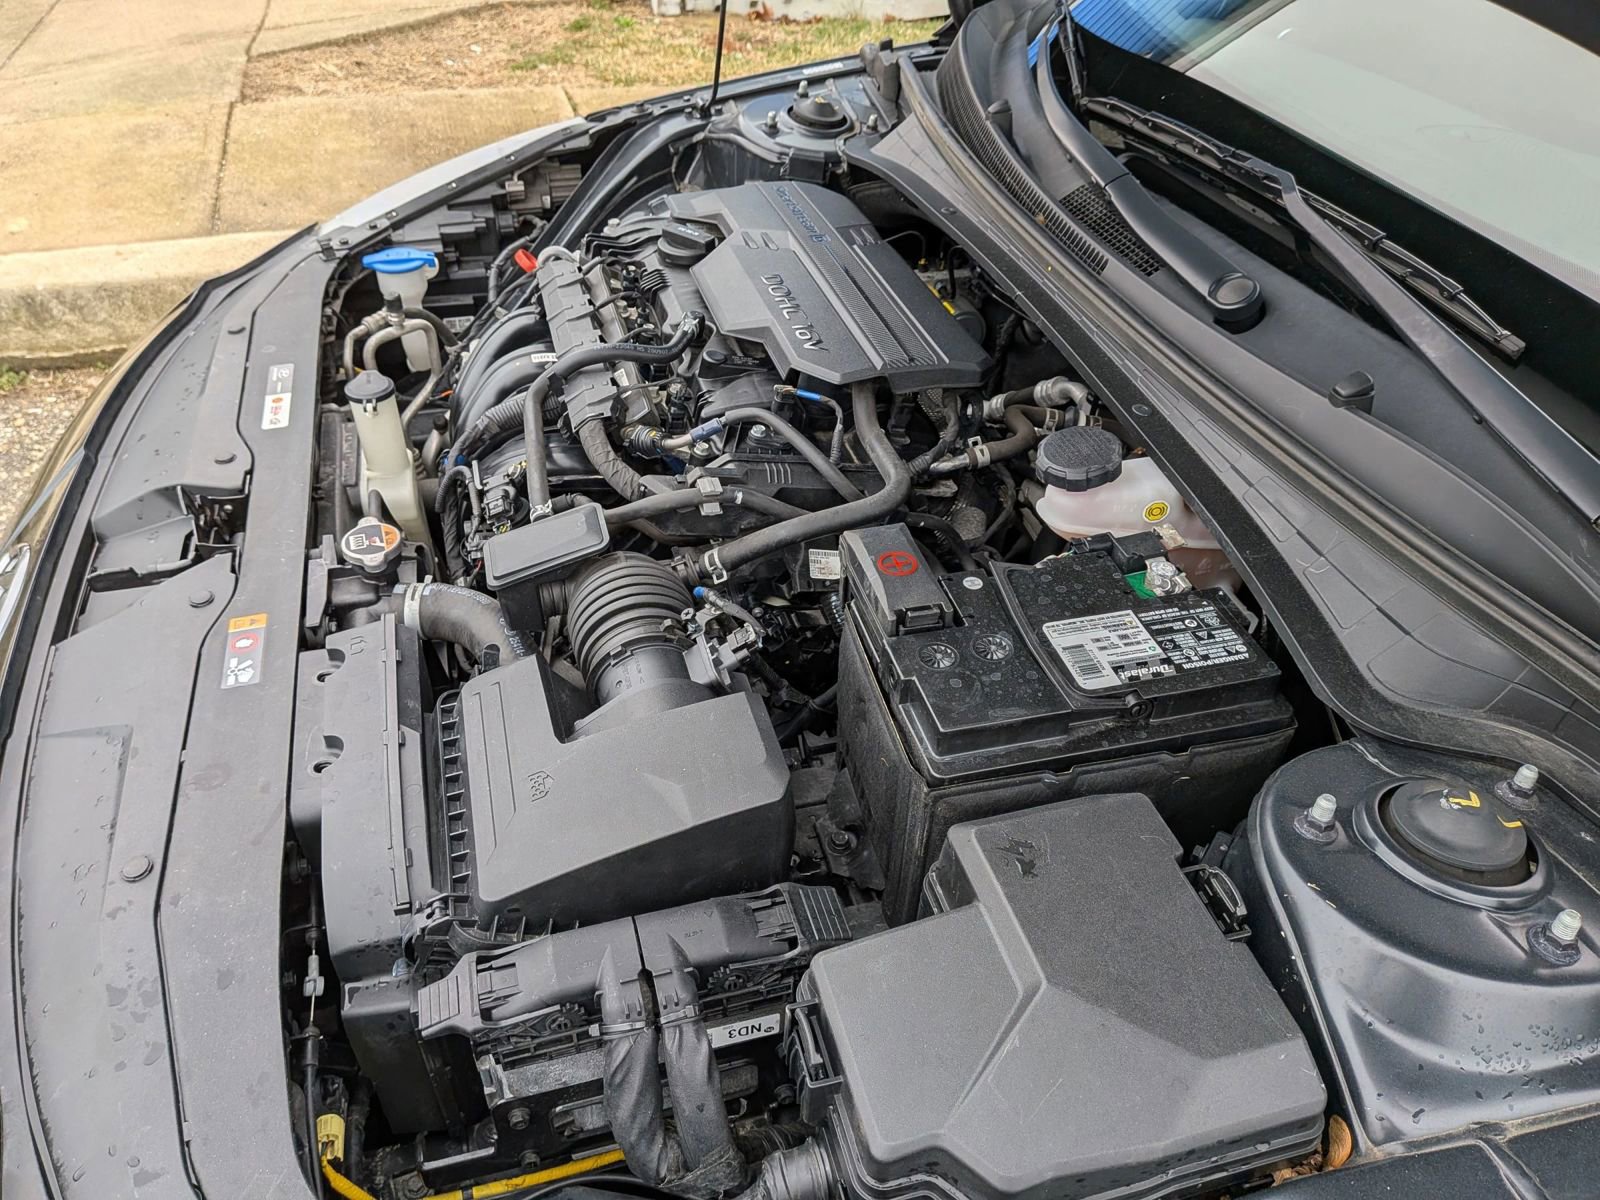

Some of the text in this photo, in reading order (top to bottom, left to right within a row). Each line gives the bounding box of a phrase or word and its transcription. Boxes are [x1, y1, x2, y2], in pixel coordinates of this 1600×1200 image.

[761, 273, 833, 352] DOHC 16V
[1118, 664, 1174, 680] Duralast
[728, 1023, 762, 1039] ND3
